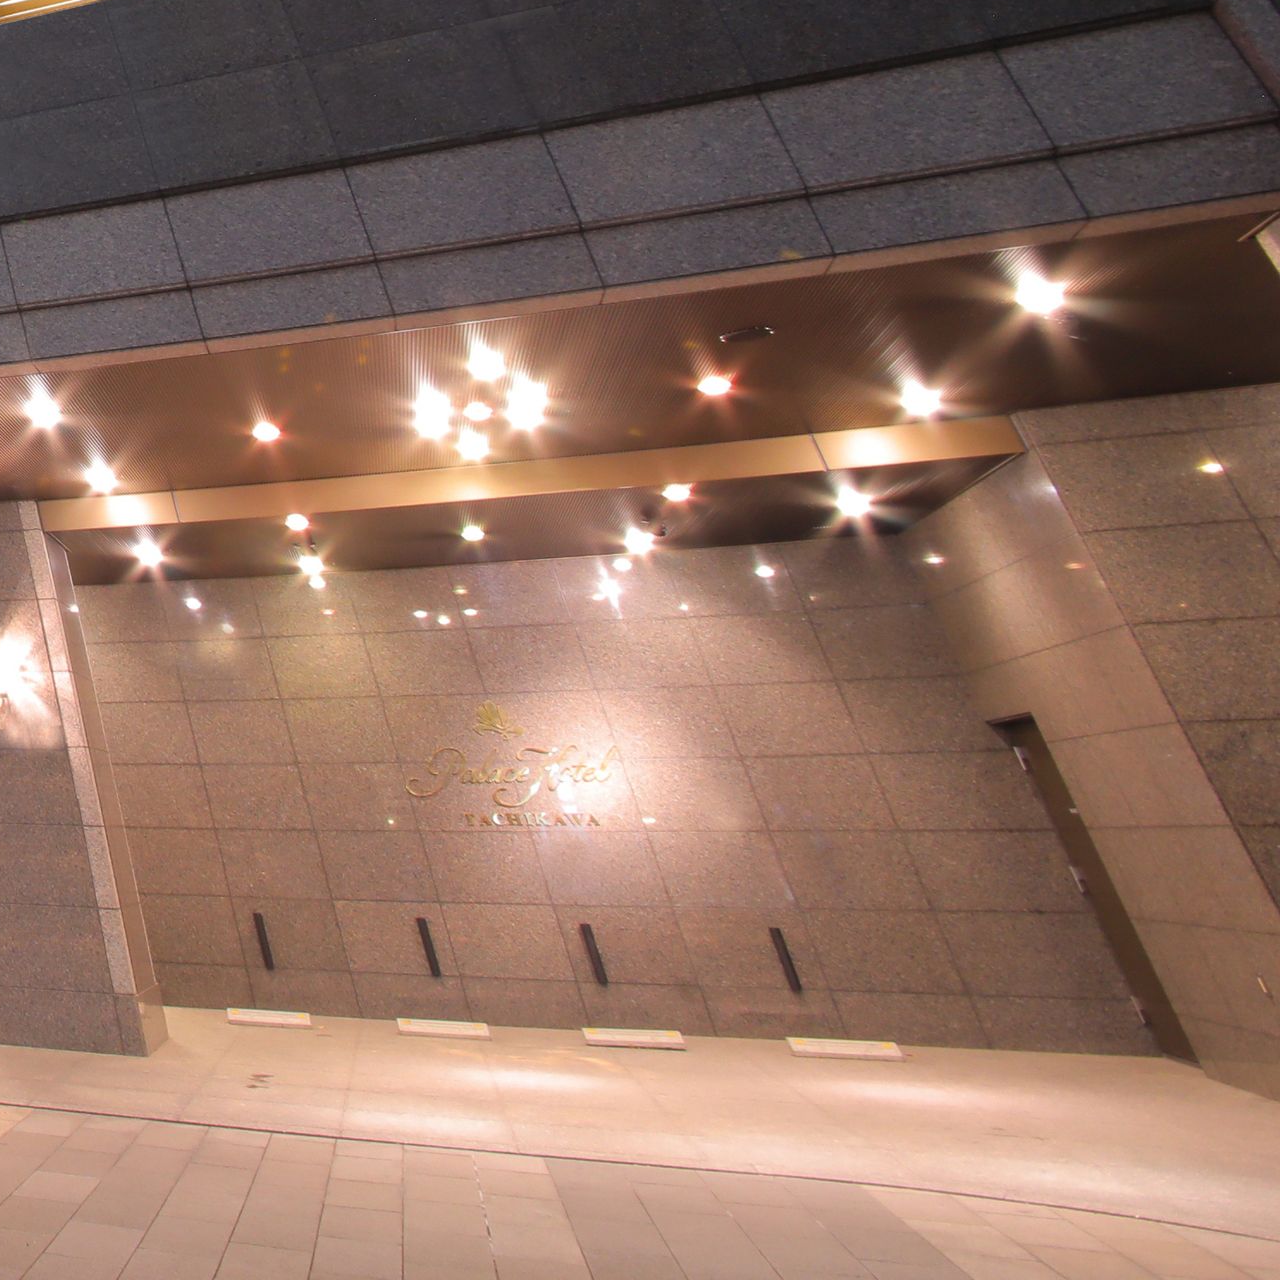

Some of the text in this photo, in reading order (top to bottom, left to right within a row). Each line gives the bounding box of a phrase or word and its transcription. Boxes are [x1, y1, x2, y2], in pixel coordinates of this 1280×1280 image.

[404, 744, 619, 808] Palace Hotel
[463, 812, 601, 827] TACHIKAWA
